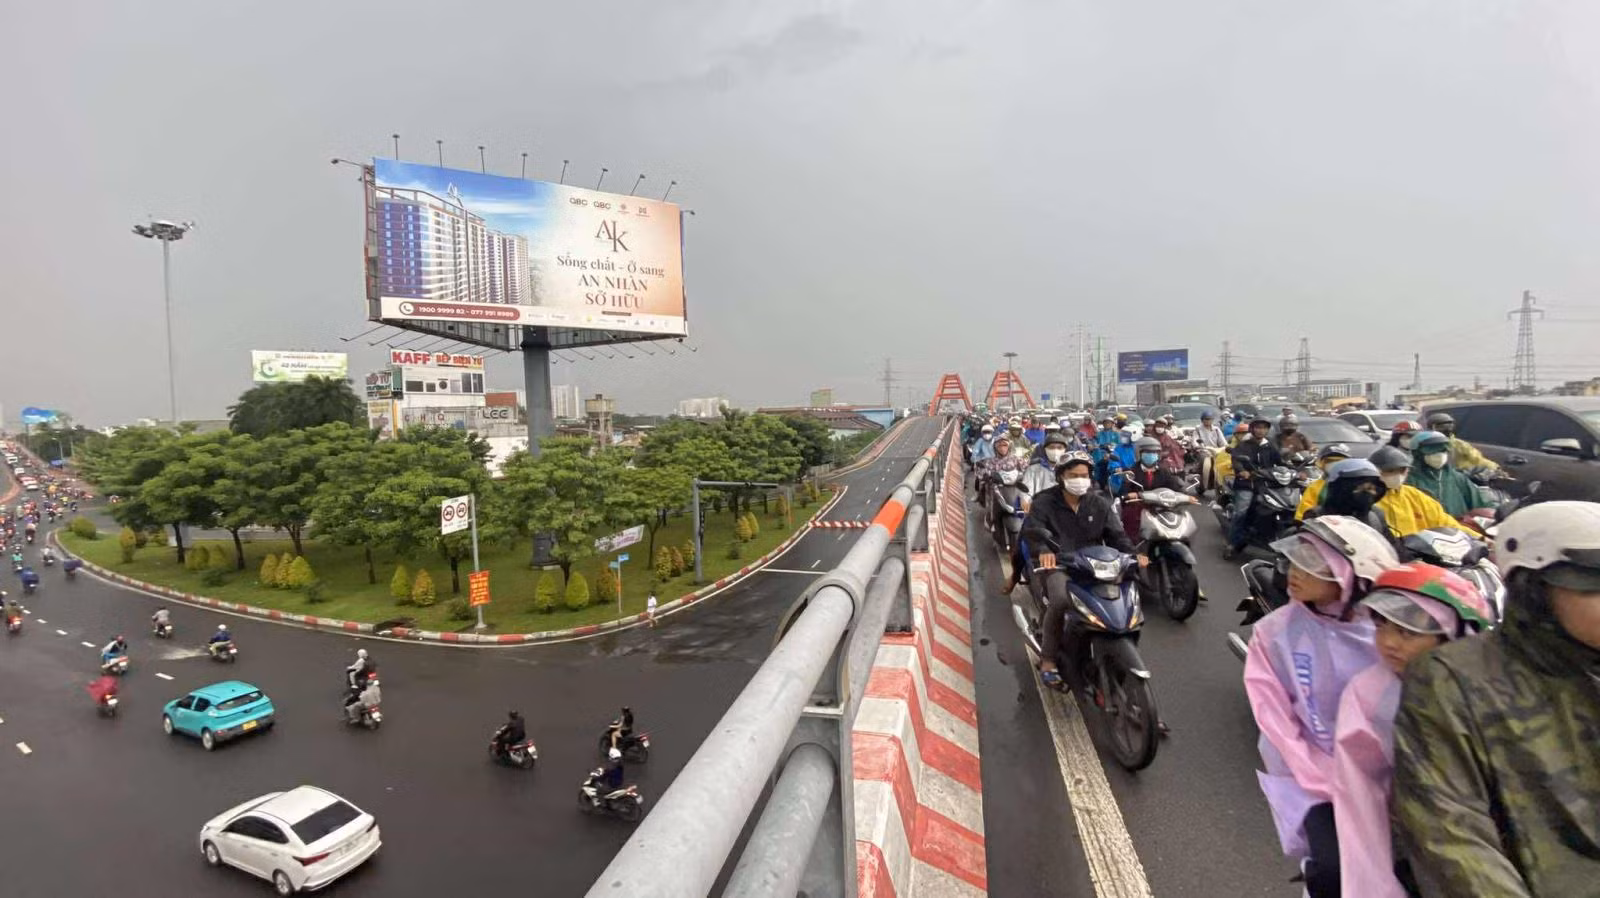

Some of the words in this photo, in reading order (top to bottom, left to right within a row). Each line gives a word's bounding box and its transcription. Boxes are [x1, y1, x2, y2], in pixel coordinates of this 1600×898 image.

[557, 252, 588, 270] Sống
[590, 256, 615, 271] chất
[640, 267, 665, 277] sang
[579, 274, 600, 287] AN
[605, 275, 648, 292] NHÀN
[585, 290, 607, 307] SỞ
[611, 293, 643, 309] HỮU
[392, 351, 431, 365] KAFF
